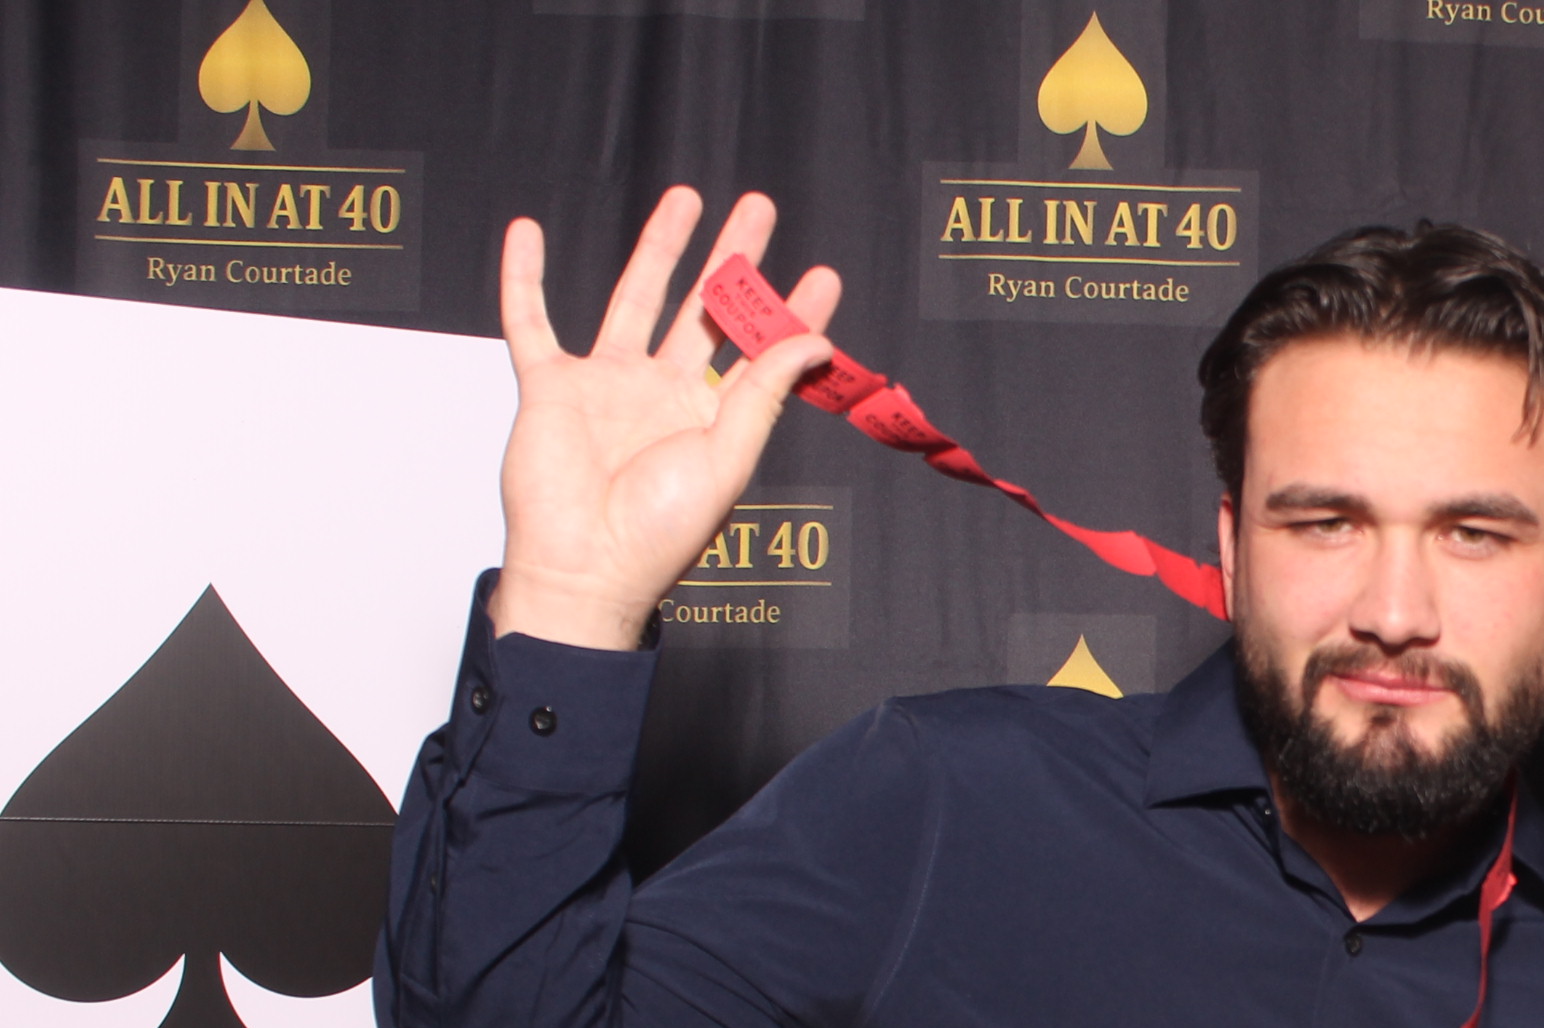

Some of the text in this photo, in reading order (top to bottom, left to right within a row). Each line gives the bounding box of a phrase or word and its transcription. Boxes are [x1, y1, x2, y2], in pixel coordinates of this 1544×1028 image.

[1426, 0, 1492, 26] Ryan
[97, 176, 401, 234] ALL IN AT 40
[940, 196, 1237, 251] ALL IN AT 40
[147, 257, 352, 287] Ryan Courtade
[988, 273, 1190, 302] Ryan Courtade
[735, 277, 773, 316] KEEP
[711, 284, 766, 344] COUPON
[893, 411, 926, 439] KEEP
[697, 521, 829, 570] AT 40
[658, 599, 781, 624] Courtade
